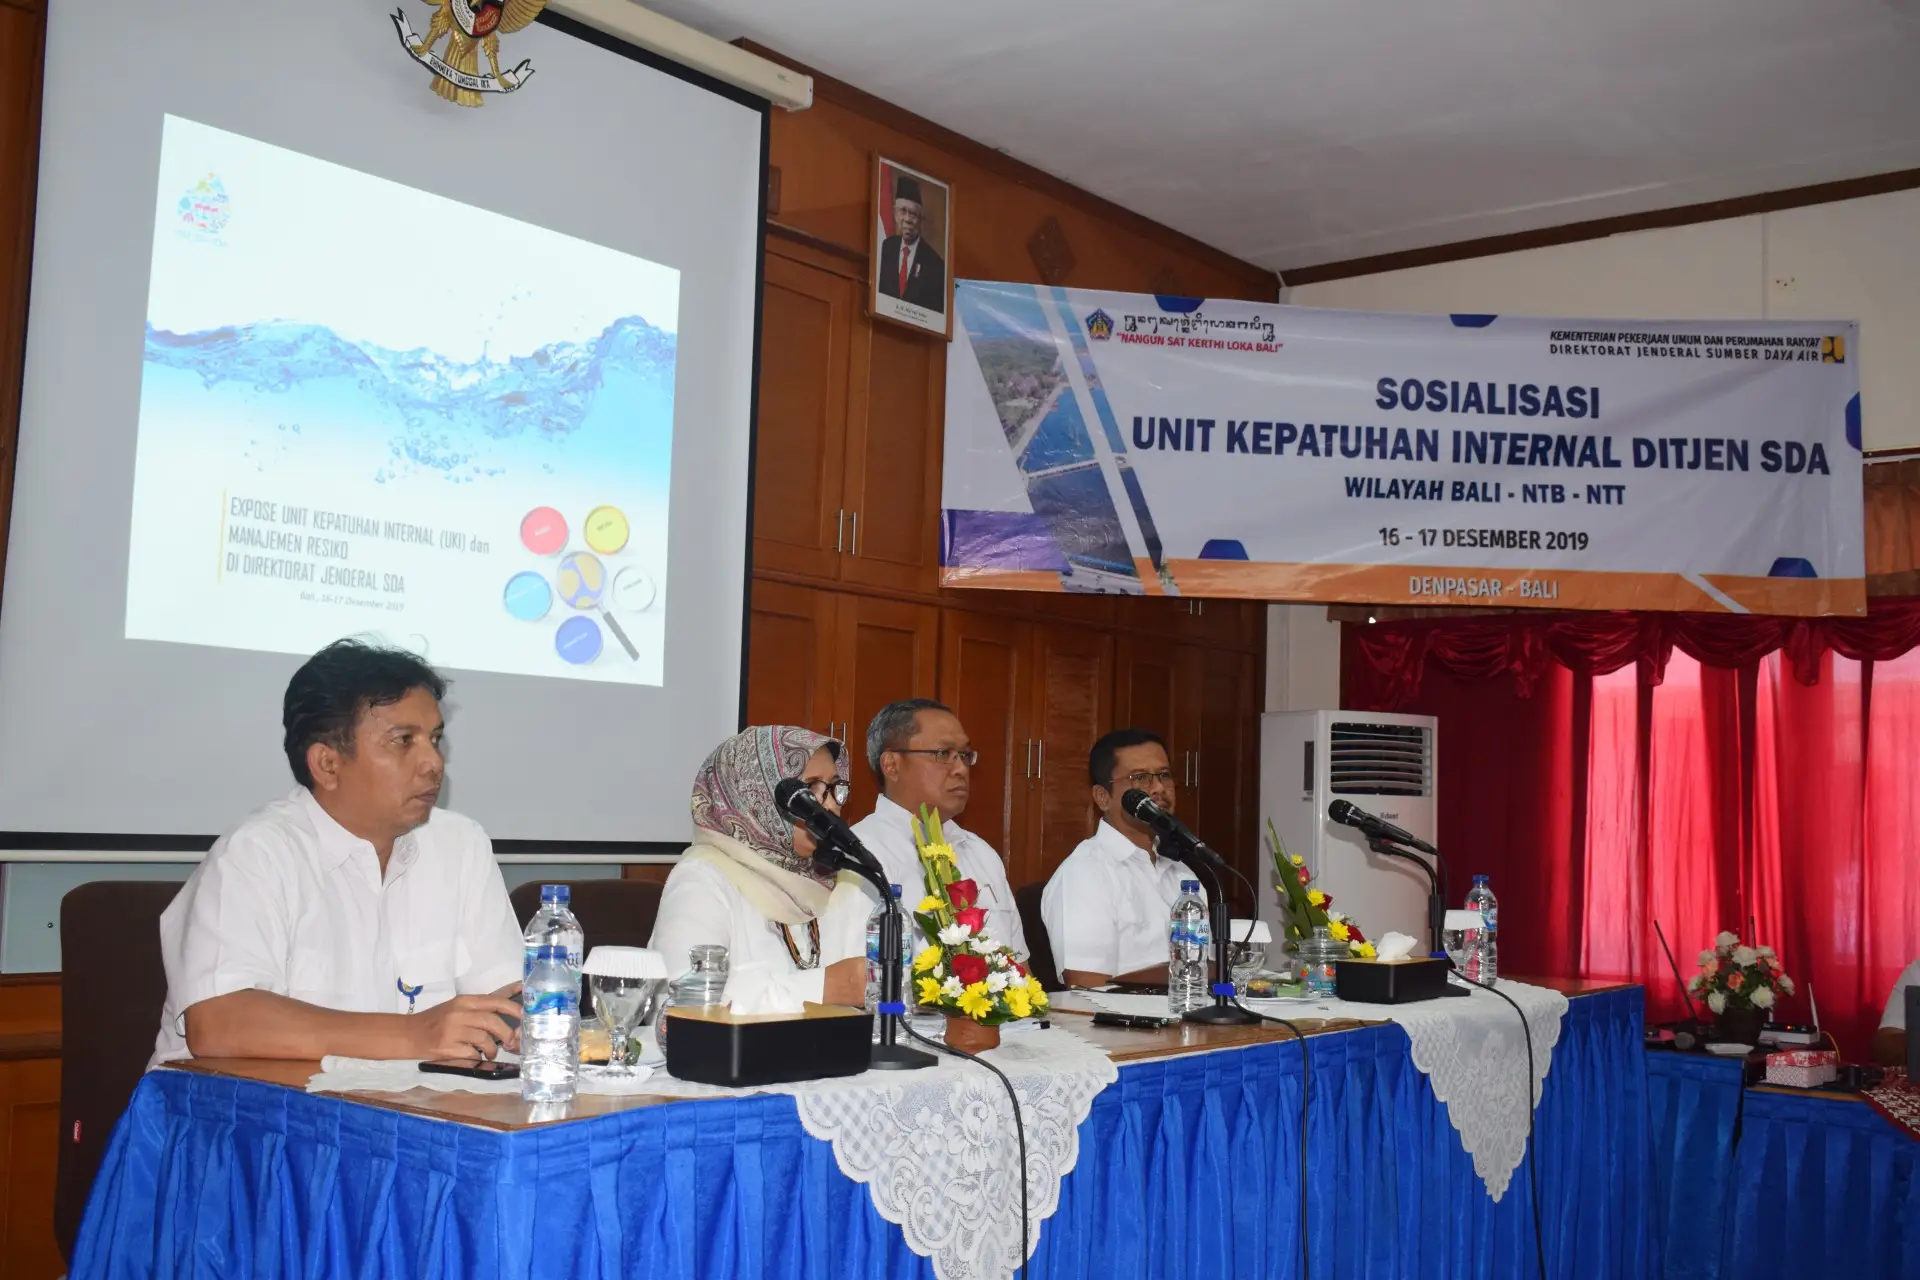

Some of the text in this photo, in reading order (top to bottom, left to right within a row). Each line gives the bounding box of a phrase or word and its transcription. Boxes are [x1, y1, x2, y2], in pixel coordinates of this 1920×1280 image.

[480, 79, 491, 89] IKA
[1167, 336, 1186, 347] SAT
[1188, 338, 1224, 349] KERTHI
[1227, 340, 1253, 351] LOKA
[1550, 331, 1821, 348] KEMENTERIAN PEKERJAAN UMUM DAN PERUMAHAN RAKYAT
[1550, 343, 1819, 361] DIREKTORAT JENDERAL SUMBER DAYA AIR
[1375, 376, 1600, 419] SOSIALISASI
[1132, 416, 1830, 476] UNIT KEPATUHAN INTERNAL DITJEN SDA
[1345, 476, 1444, 501] WILAYAH
[1451, 481, 1501, 503] BALI
[1522, 483, 1565, 503] NTB
[1587, 484, 1626, 505] NTT
[230, 496, 490, 554] EXPOSE UNIT KEPATUHAN INTERNAL (UKI) dan
[228, 524, 349, 560] MANAJEMEN RESIKO
[1379, 527, 1400, 547] 16
[1418, 529, 1437, 547] 17
[1443, 529, 1541, 550] DESEMBER
[1546, 531, 1589, 551] 2019
[226, 552, 405, 593] DI DIREKTORAT JENDERAL SDA
[1409, 576, 1503, 597] DENPASAR
[1520, 579, 1559, 599] BALI
[345, 596, 384, 609] Desember
